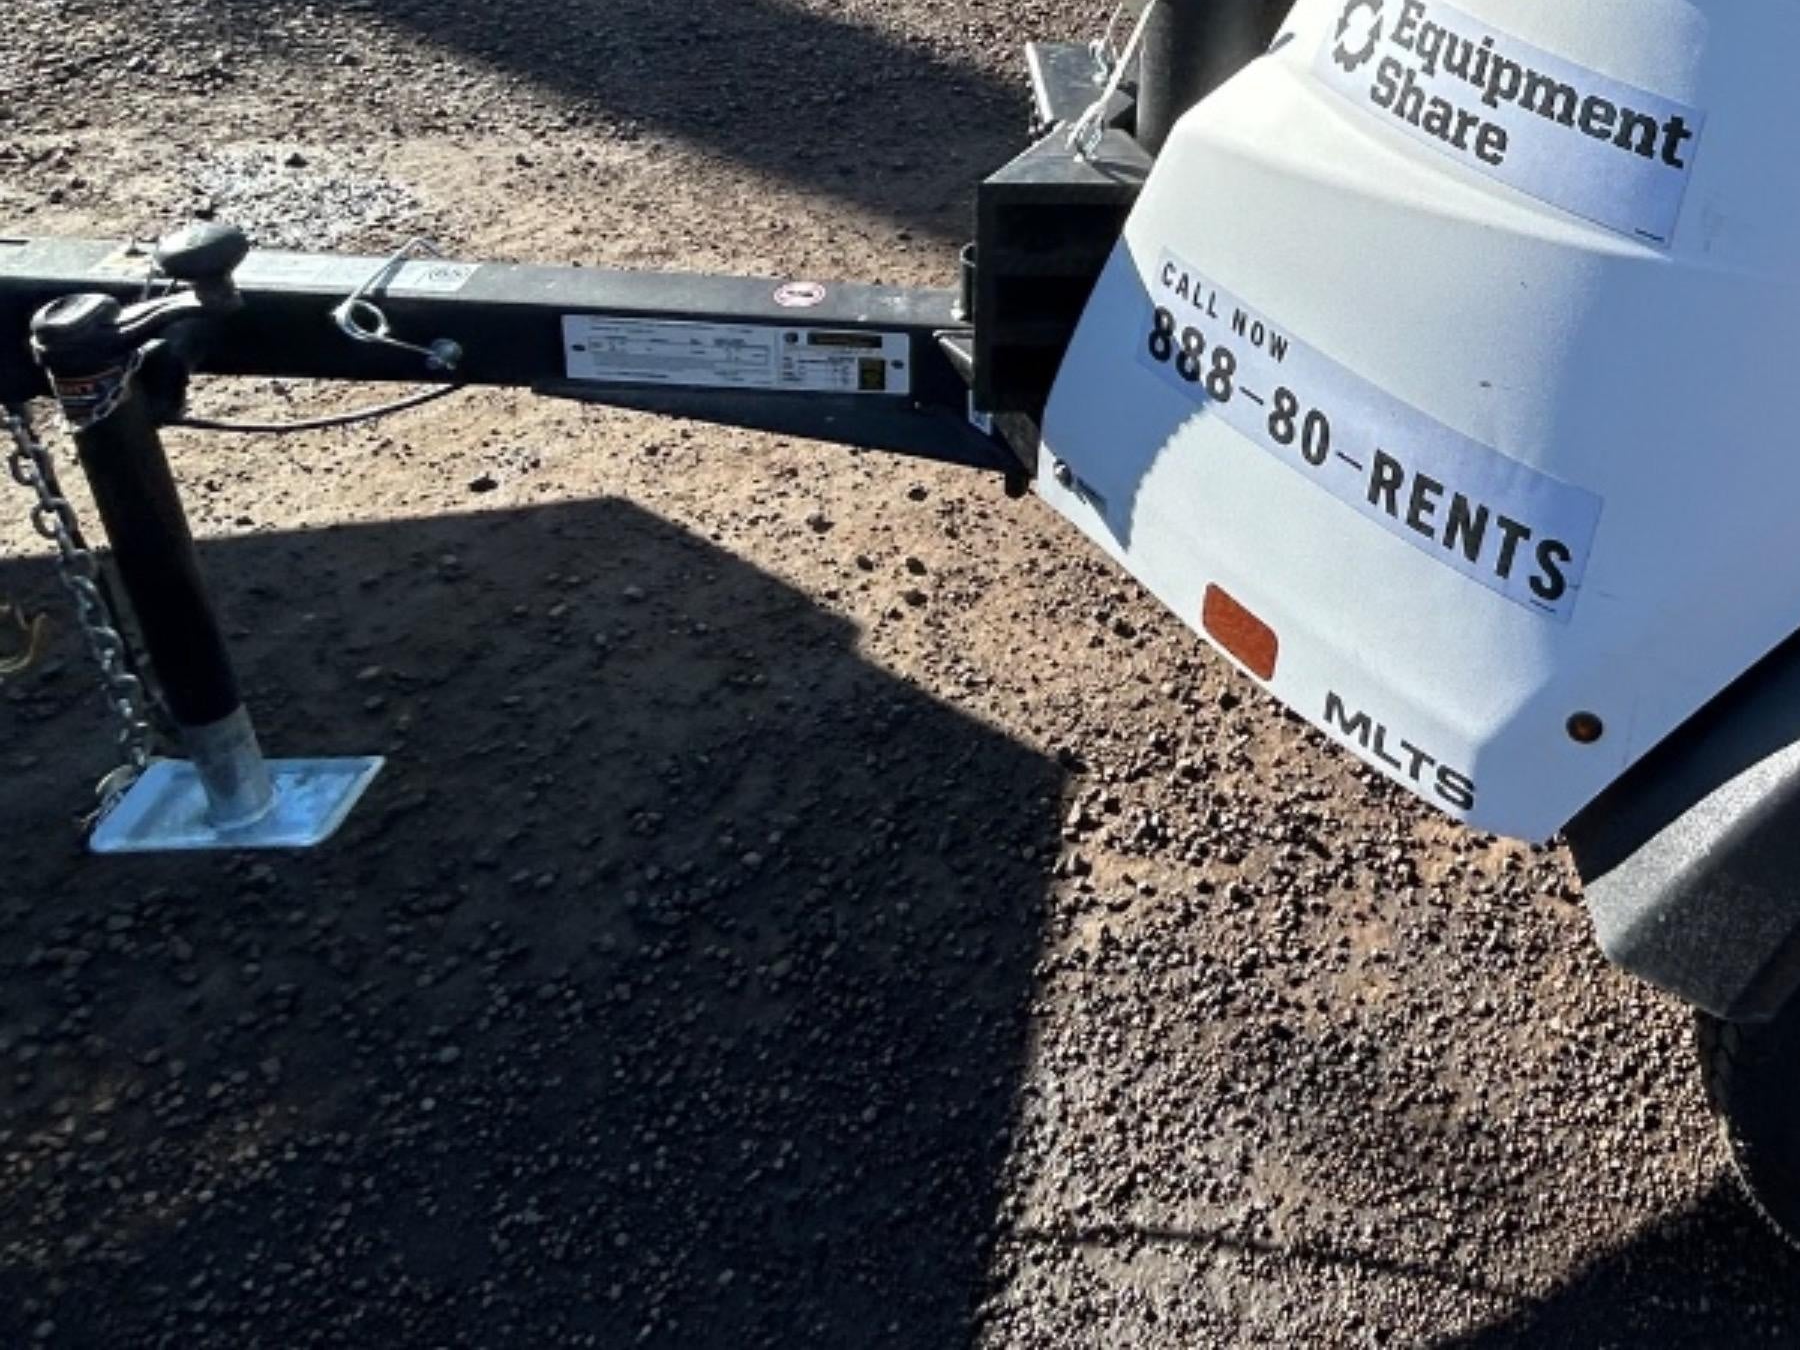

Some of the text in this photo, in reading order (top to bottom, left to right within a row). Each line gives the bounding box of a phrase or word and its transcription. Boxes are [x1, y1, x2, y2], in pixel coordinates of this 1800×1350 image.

[1369, 54, 1509, 167] Share
[1160, 261, 1291, 364] CALL NOW
[1146, 305, 1573, 603] 888-80-RENTS
[1322, 689, 1476, 811] MLTS
